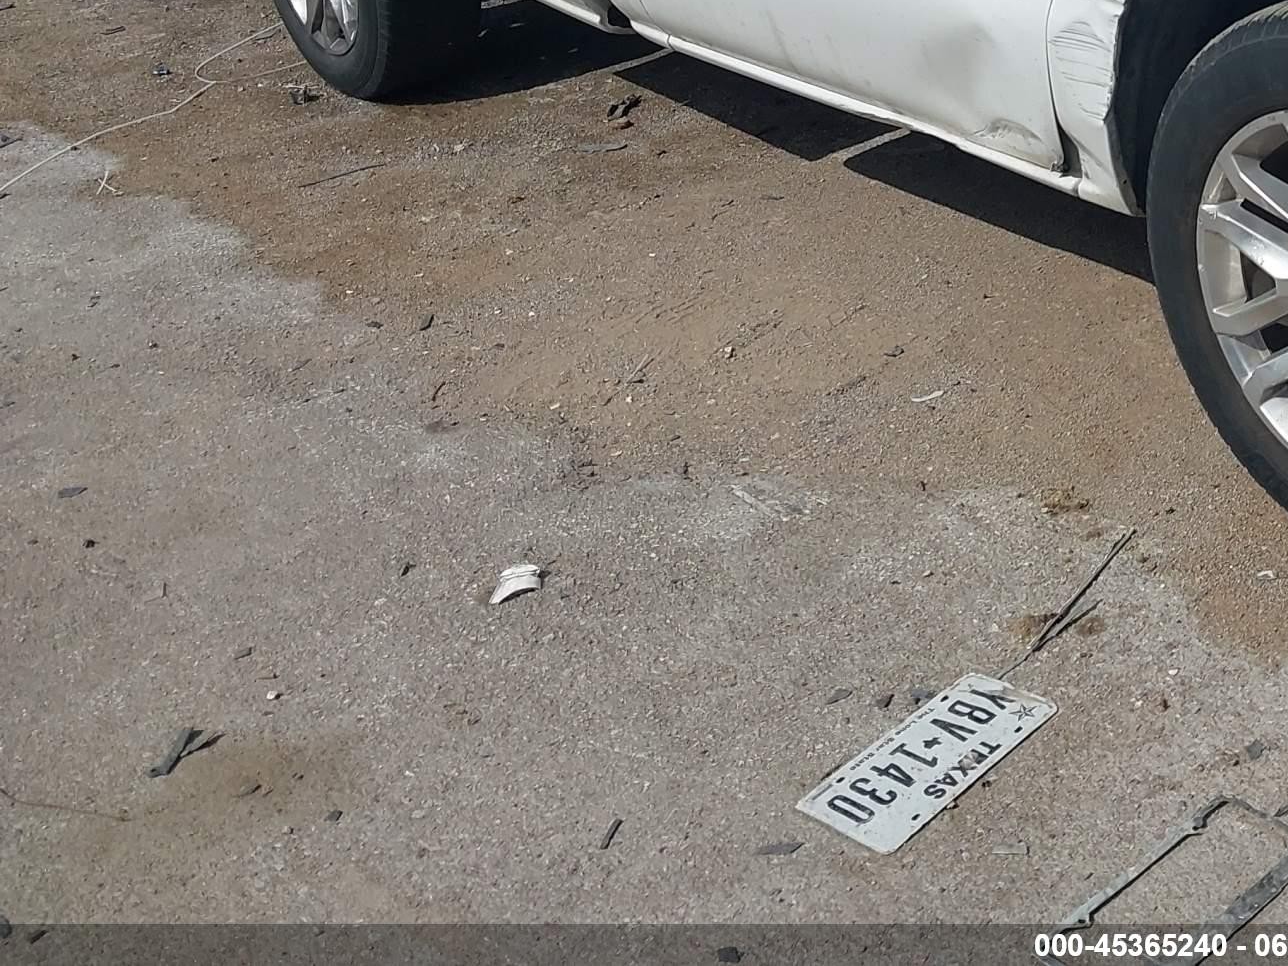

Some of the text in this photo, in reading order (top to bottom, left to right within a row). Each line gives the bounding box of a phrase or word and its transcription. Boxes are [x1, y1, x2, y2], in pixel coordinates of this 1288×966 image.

[849, 707, 935, 771] The Lone Star State
[923, 741, 1002, 799] TEXAS
